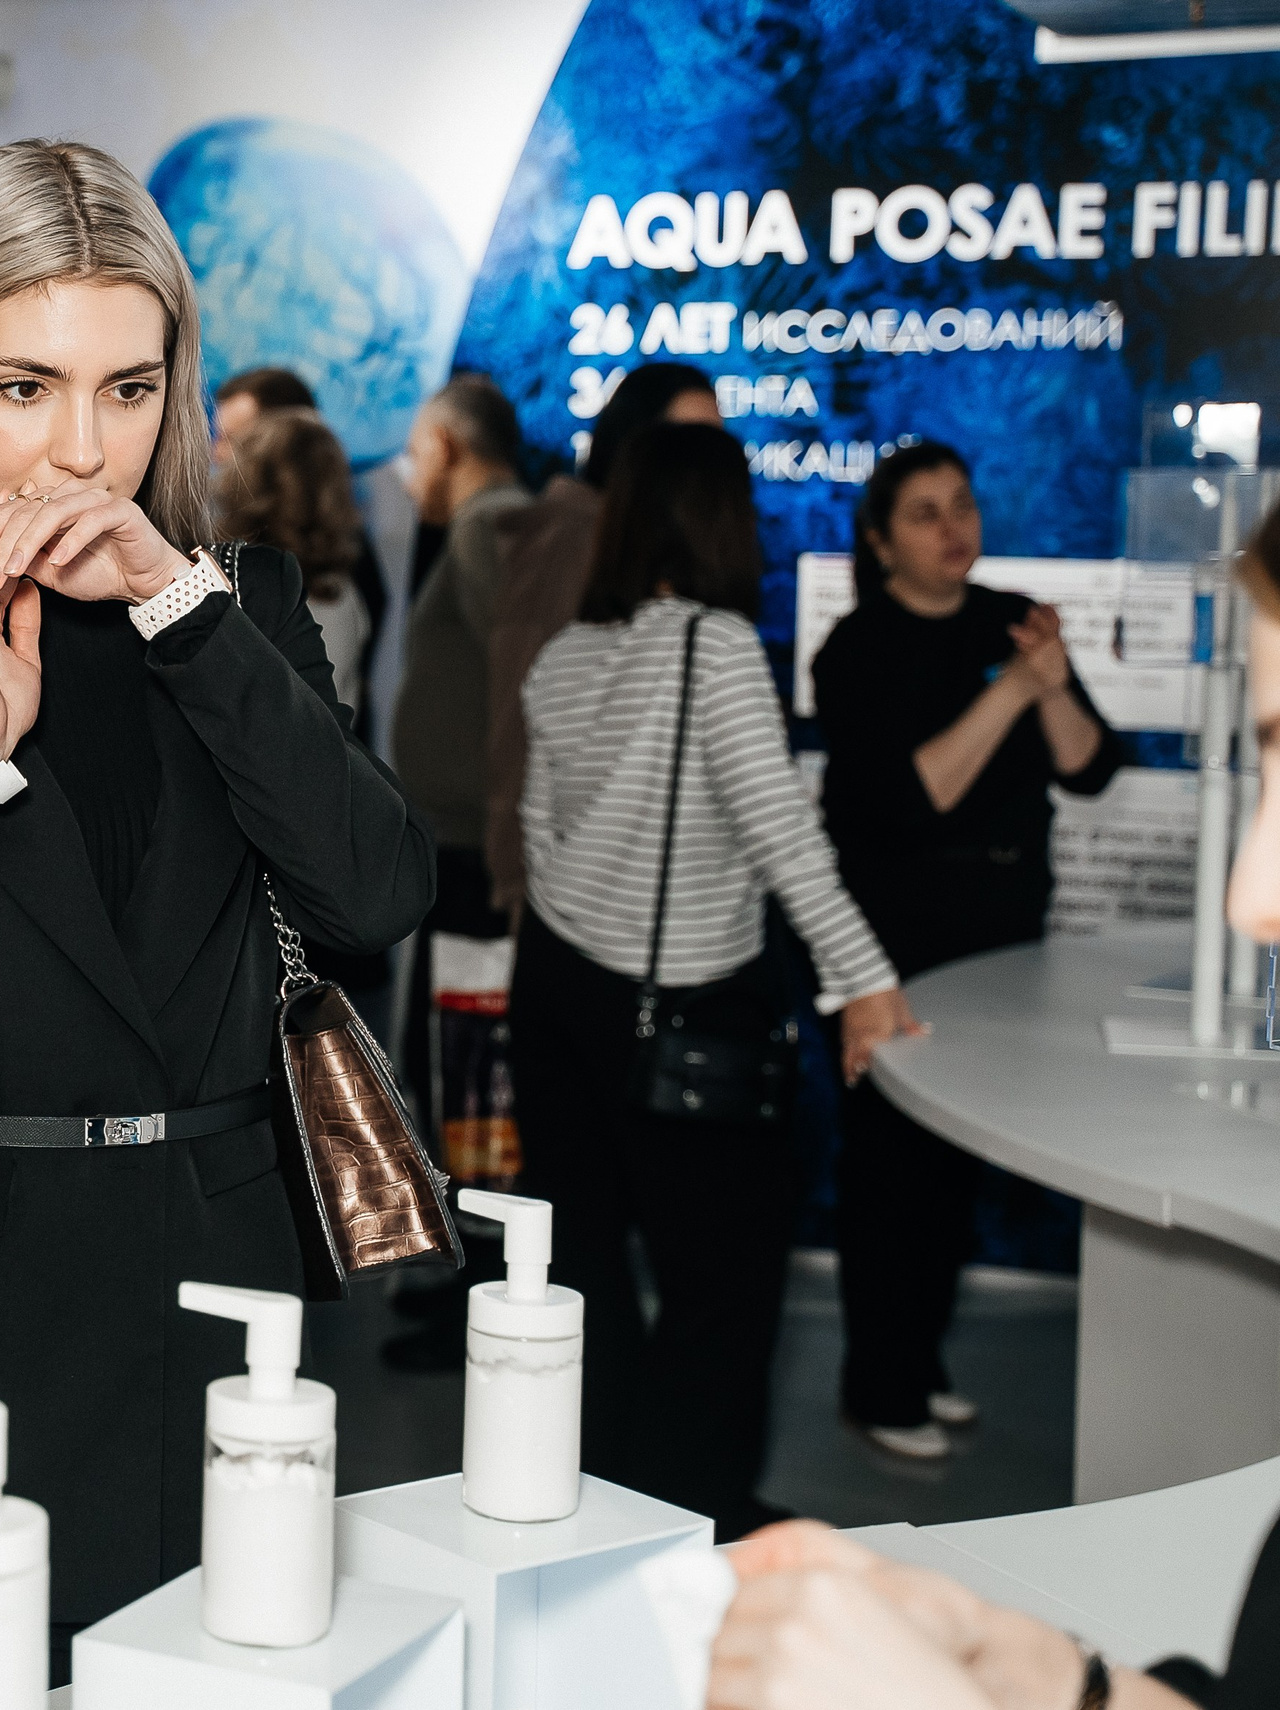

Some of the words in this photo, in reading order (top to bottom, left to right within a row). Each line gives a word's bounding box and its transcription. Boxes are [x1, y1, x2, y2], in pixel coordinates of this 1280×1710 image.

[566, 190, 808, 271] AQUA
[830, 184, 1107, 263] POSAE
[1131, 179, 1280, 259] FILI
[568, 302, 634, 355] 26
[639, 302, 738, 355] ЛЕТ
[743, 300, 1123, 355] ИССЛЕДОВАНИЙ
[715, 375, 819, 418] ЕНТА
